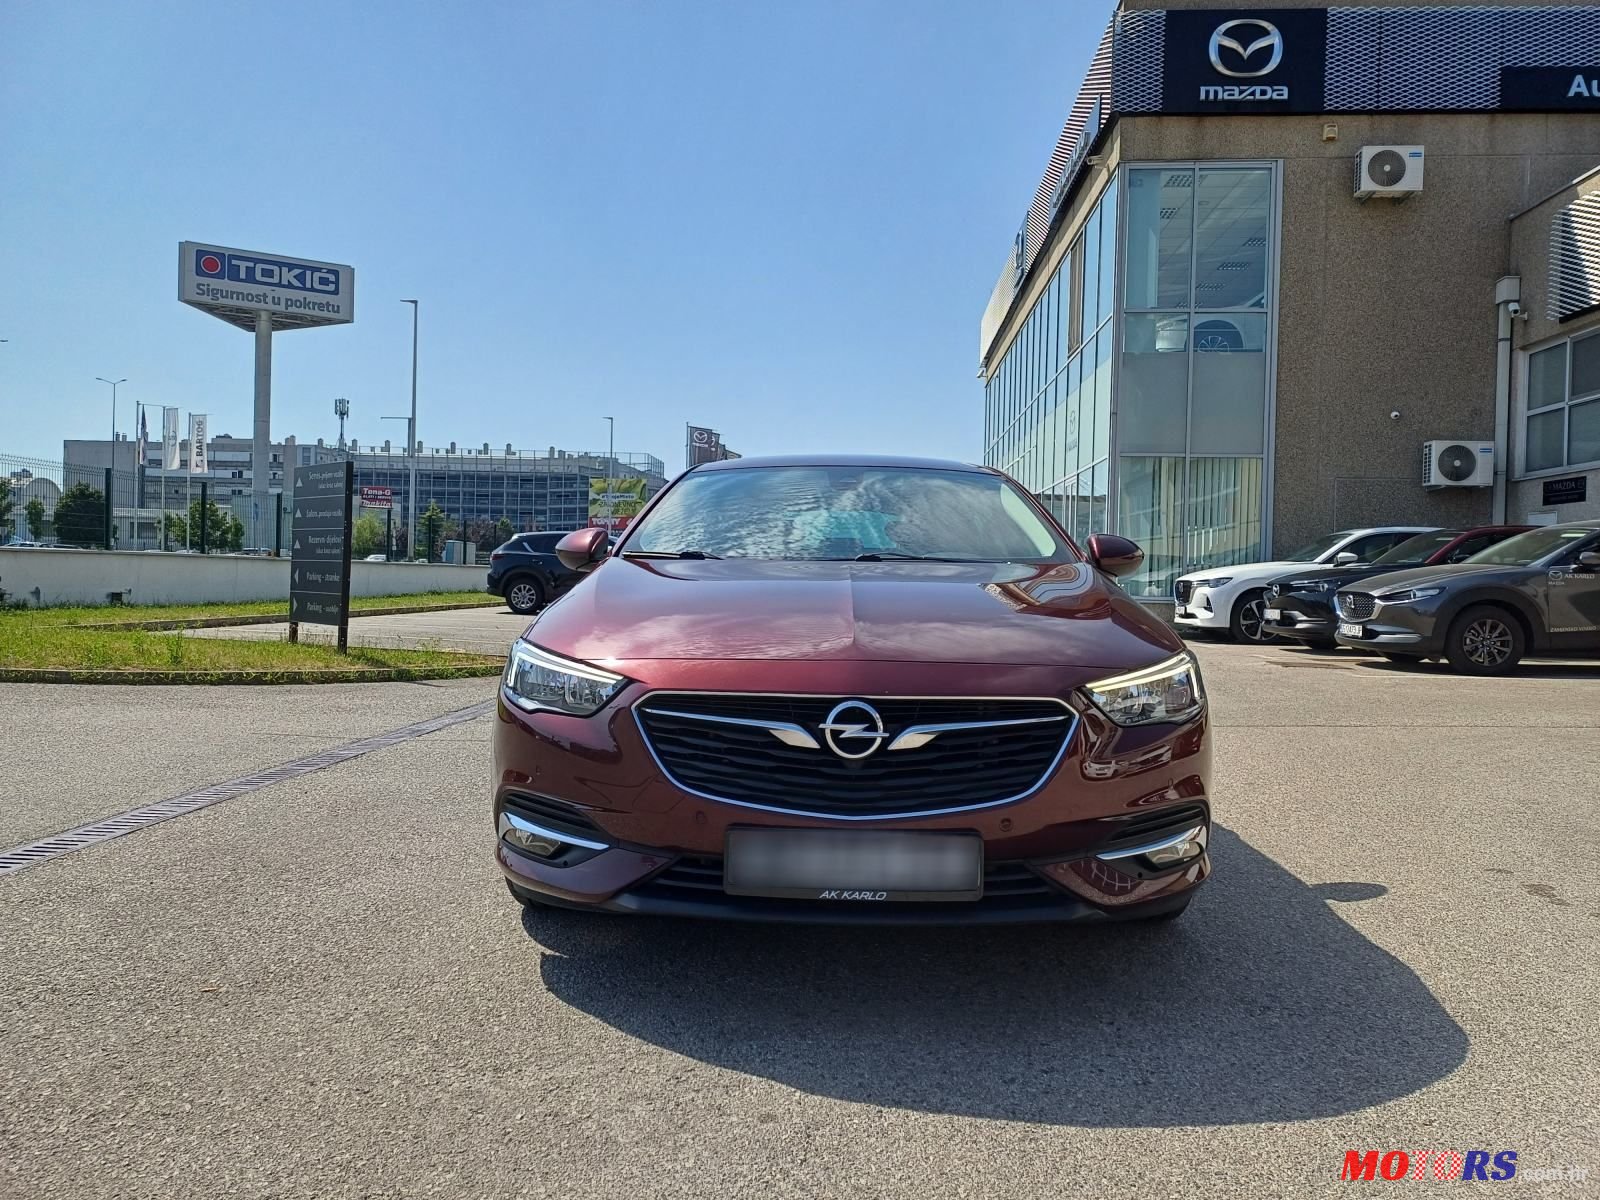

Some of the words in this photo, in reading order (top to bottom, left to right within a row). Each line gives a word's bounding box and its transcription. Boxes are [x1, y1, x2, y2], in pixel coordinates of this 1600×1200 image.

[231, 259, 336, 292] TOKIĆ
[195, 282, 269, 305] Sigurnost
[271, 293, 281, 306] u
[285, 295, 341, 314] pokretu
[819, 890, 840, 899] AK
[841, 890, 887, 900] KARLO
